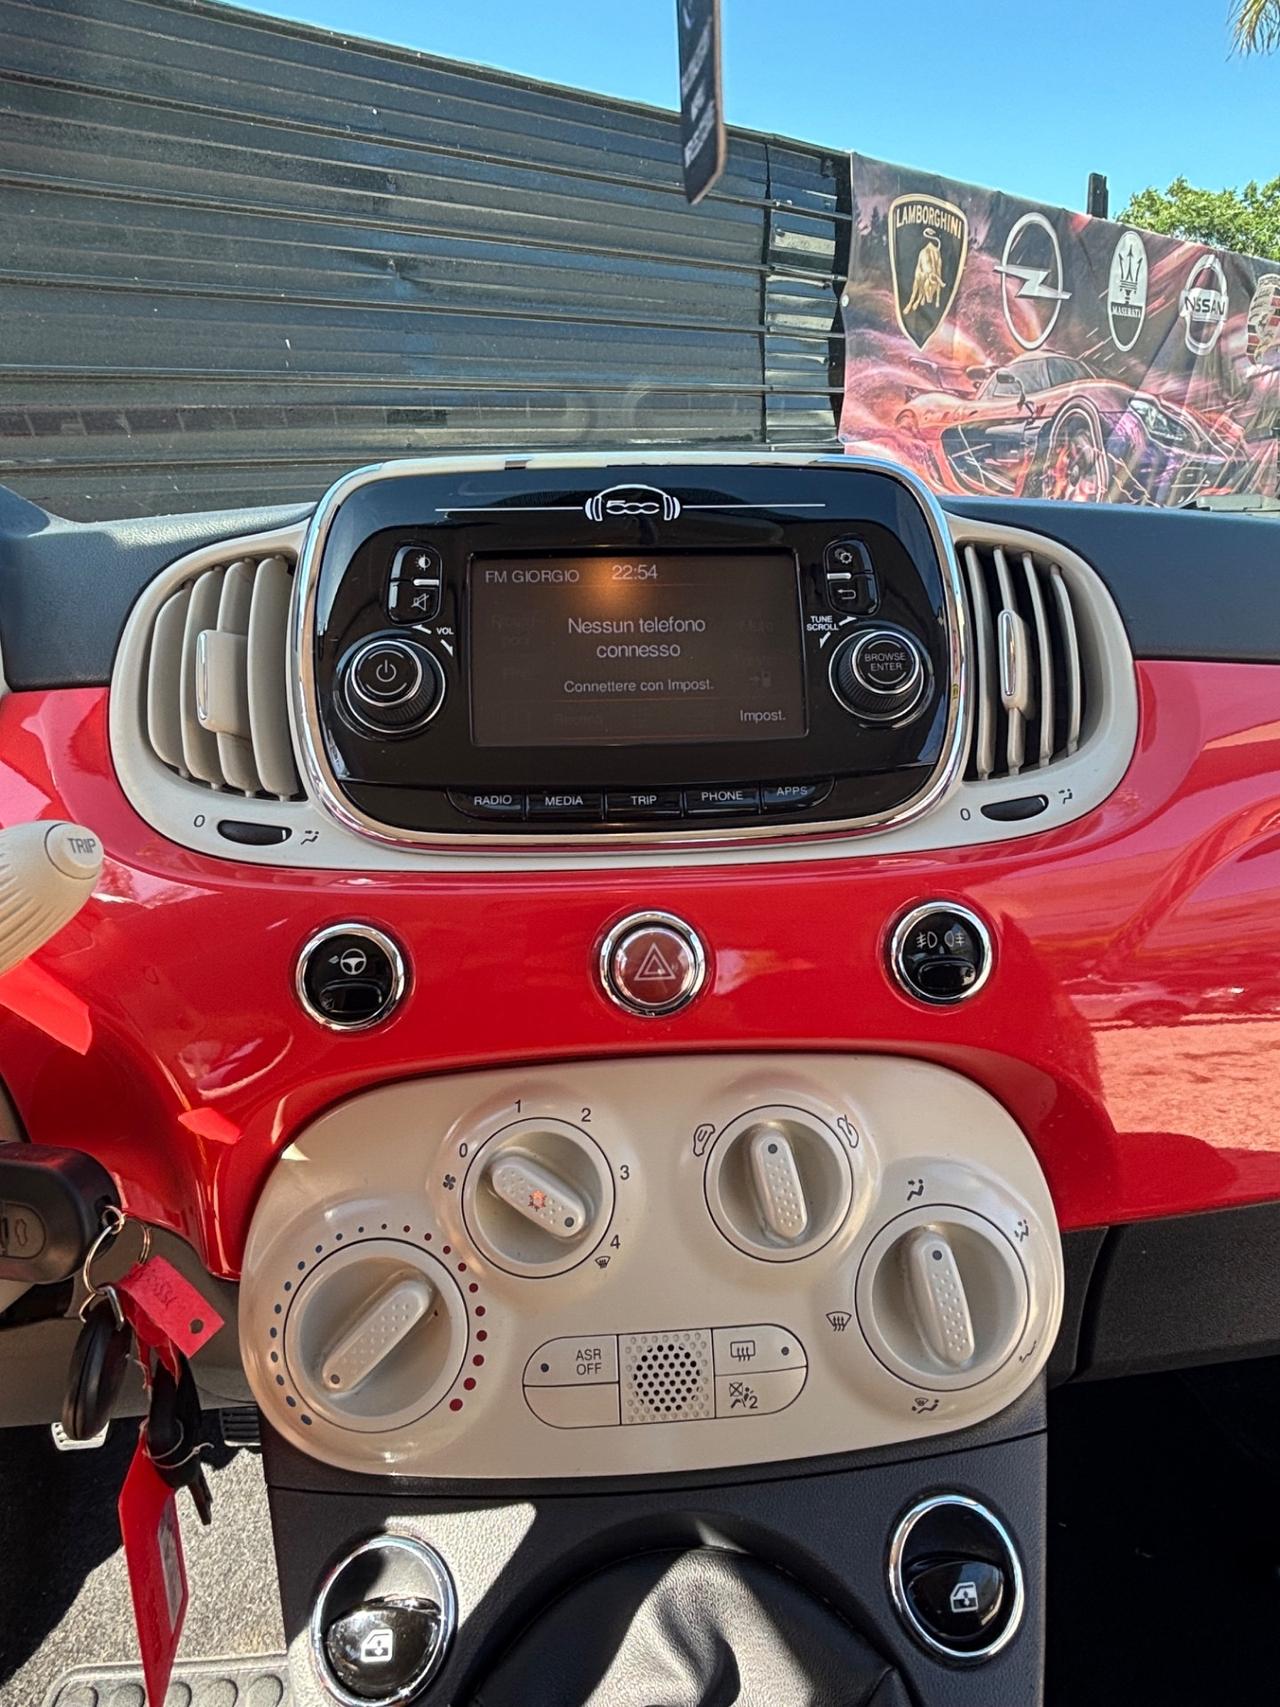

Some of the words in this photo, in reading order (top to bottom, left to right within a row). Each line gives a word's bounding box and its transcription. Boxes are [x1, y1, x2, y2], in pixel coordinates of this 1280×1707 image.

[896, 204, 962, 240] LAMBORGHINI
[1184, 296, 1226, 315] NSSAN
[606, 500, 660, 515] 500
[485, 570, 508, 583] FM
[512, 569, 580, 583] GIORGIO
[611, 564, 659, 581] 22:54
[567, 617, 635, 634] Nessun
[638, 616, 706, 634] telefono
[810, 615, 833, 623] TUNE
[436, 627, 454, 635] VOL
[806, 623, 839, 632] SCROLL
[596, 644, 681, 659] connesso
[864, 652, 907, 662] BROWSE
[870, 662, 903, 672] ENTER
[563, 680, 639, 694] Connettere
[641, 680, 664, 692] con
[667, 678, 715, 693] Impost.
[739, 709, 787, 724] Impost.
[701, 790, 744, 801] PHONE
[775, 786, 809, 797] APPS
[473, 795, 513, 805] RADIO
[545, 795, 584, 806] MEDIA
[631, 795, 658, 806] TRIP
[67, 836, 97, 855] TRIP
[514, 1099, 522, 1113] 1
[580, 1107, 592, 1122] 2
[458, 1142, 469, 1158] 0
[619, 1165, 631, 1180] 3
[609, 1234, 621, 1249] 4
[575, 1349, 602, 1361] ASR
[575, 1362, 602, 1376] OFF
